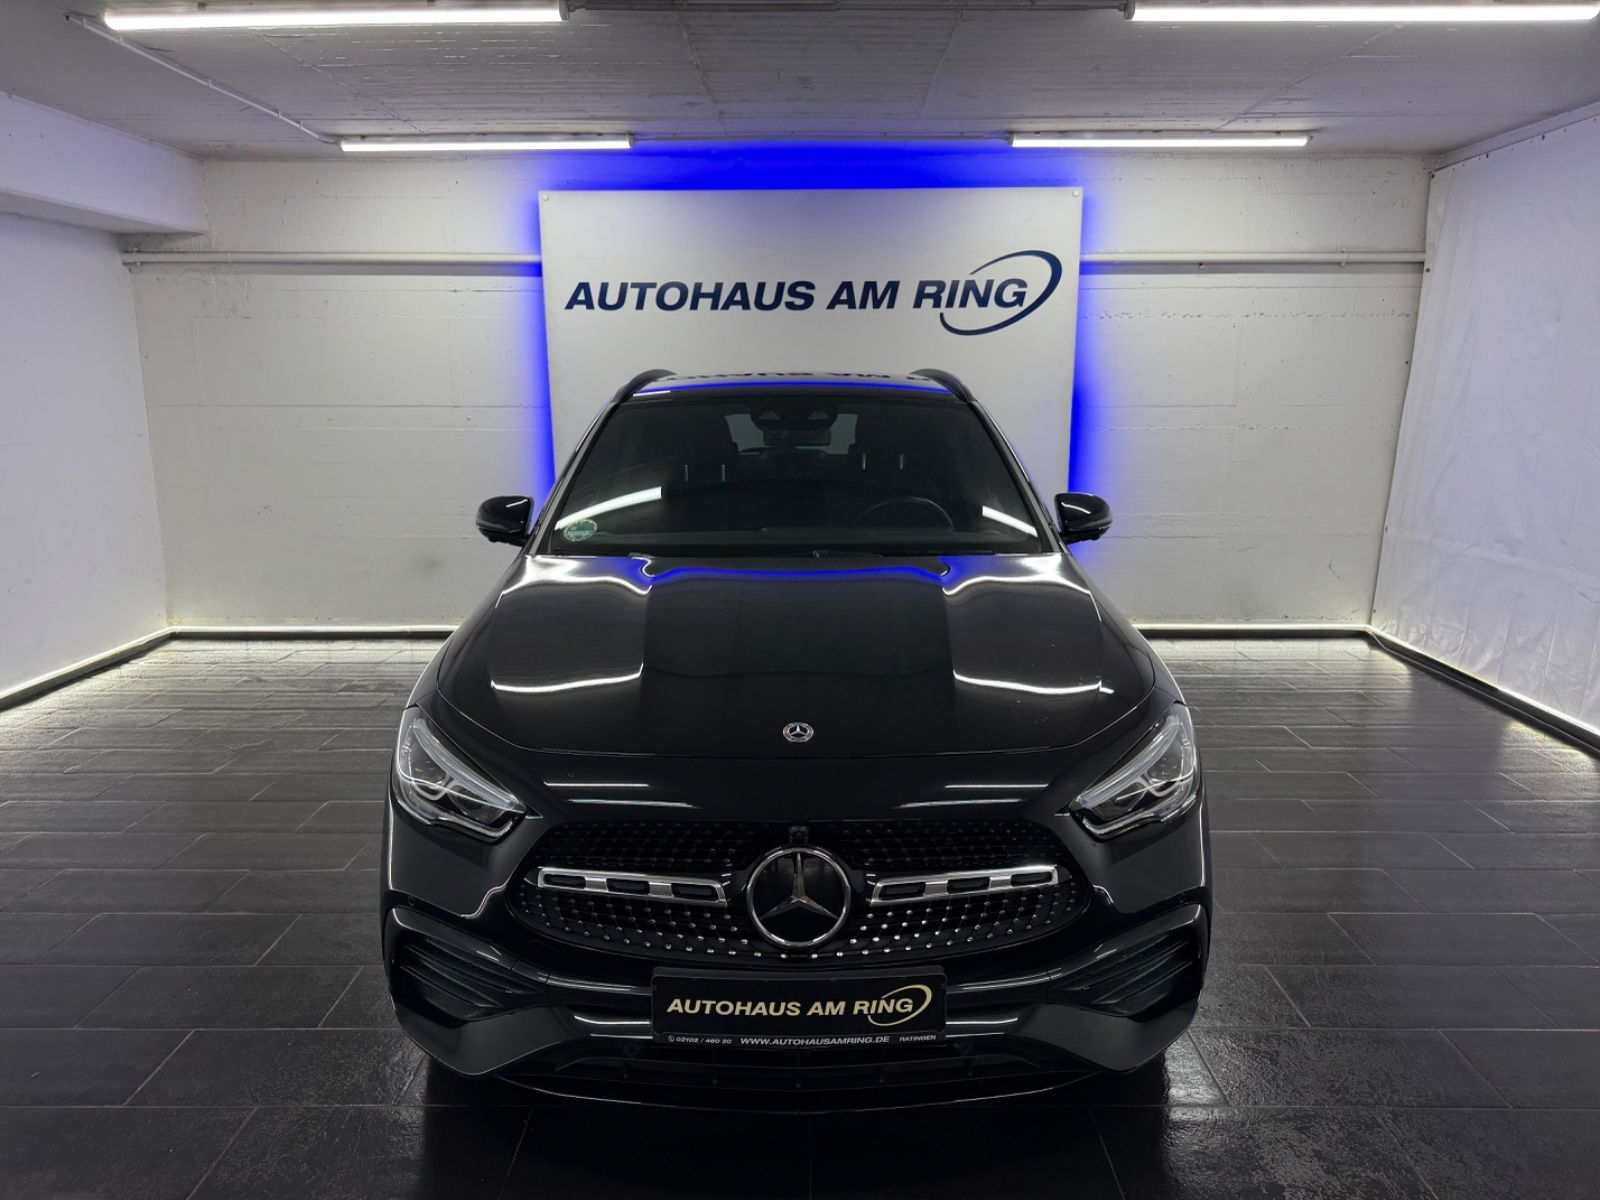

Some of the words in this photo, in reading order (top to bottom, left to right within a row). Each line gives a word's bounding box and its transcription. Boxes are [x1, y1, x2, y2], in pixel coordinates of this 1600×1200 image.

[565, 281, 815, 311] AUTOHAUS
[826, 280, 900, 309] AM
[912, 278, 1029, 309] RING
[667, 998, 801, 1016] AUTOHAUS
[806, 1001, 846, 1016] AM
[853, 998, 914, 1015] RING
[740, 1036, 890, 1046] WWW.AUTOHAUSAMRING.DE
